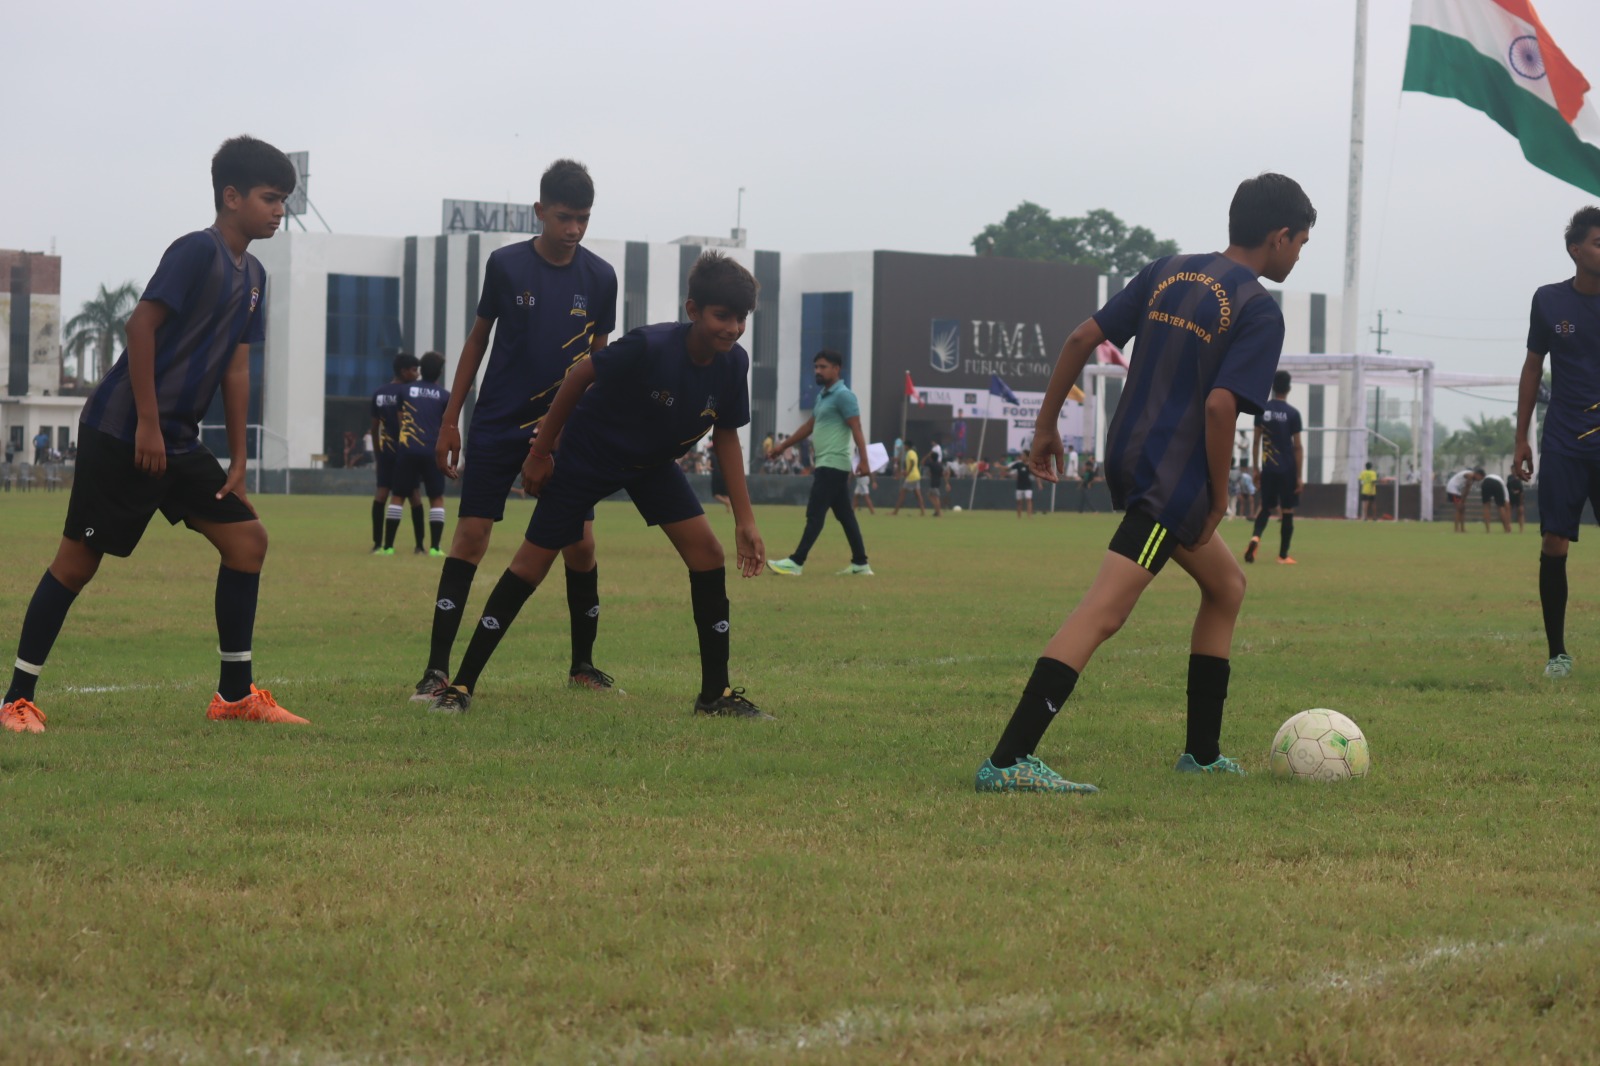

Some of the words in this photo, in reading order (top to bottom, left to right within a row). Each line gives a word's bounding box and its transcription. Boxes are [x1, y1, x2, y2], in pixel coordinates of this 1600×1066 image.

[1211, 282, 1231, 334] SCHOOL
[971, 320, 1046, 359] UMA
[1010, 361, 1052, 377] SCOO
[383, 394, 397, 403] UM
[419, 387, 440, 398] UMA
[1003, 407, 1068, 418] FOOTL
